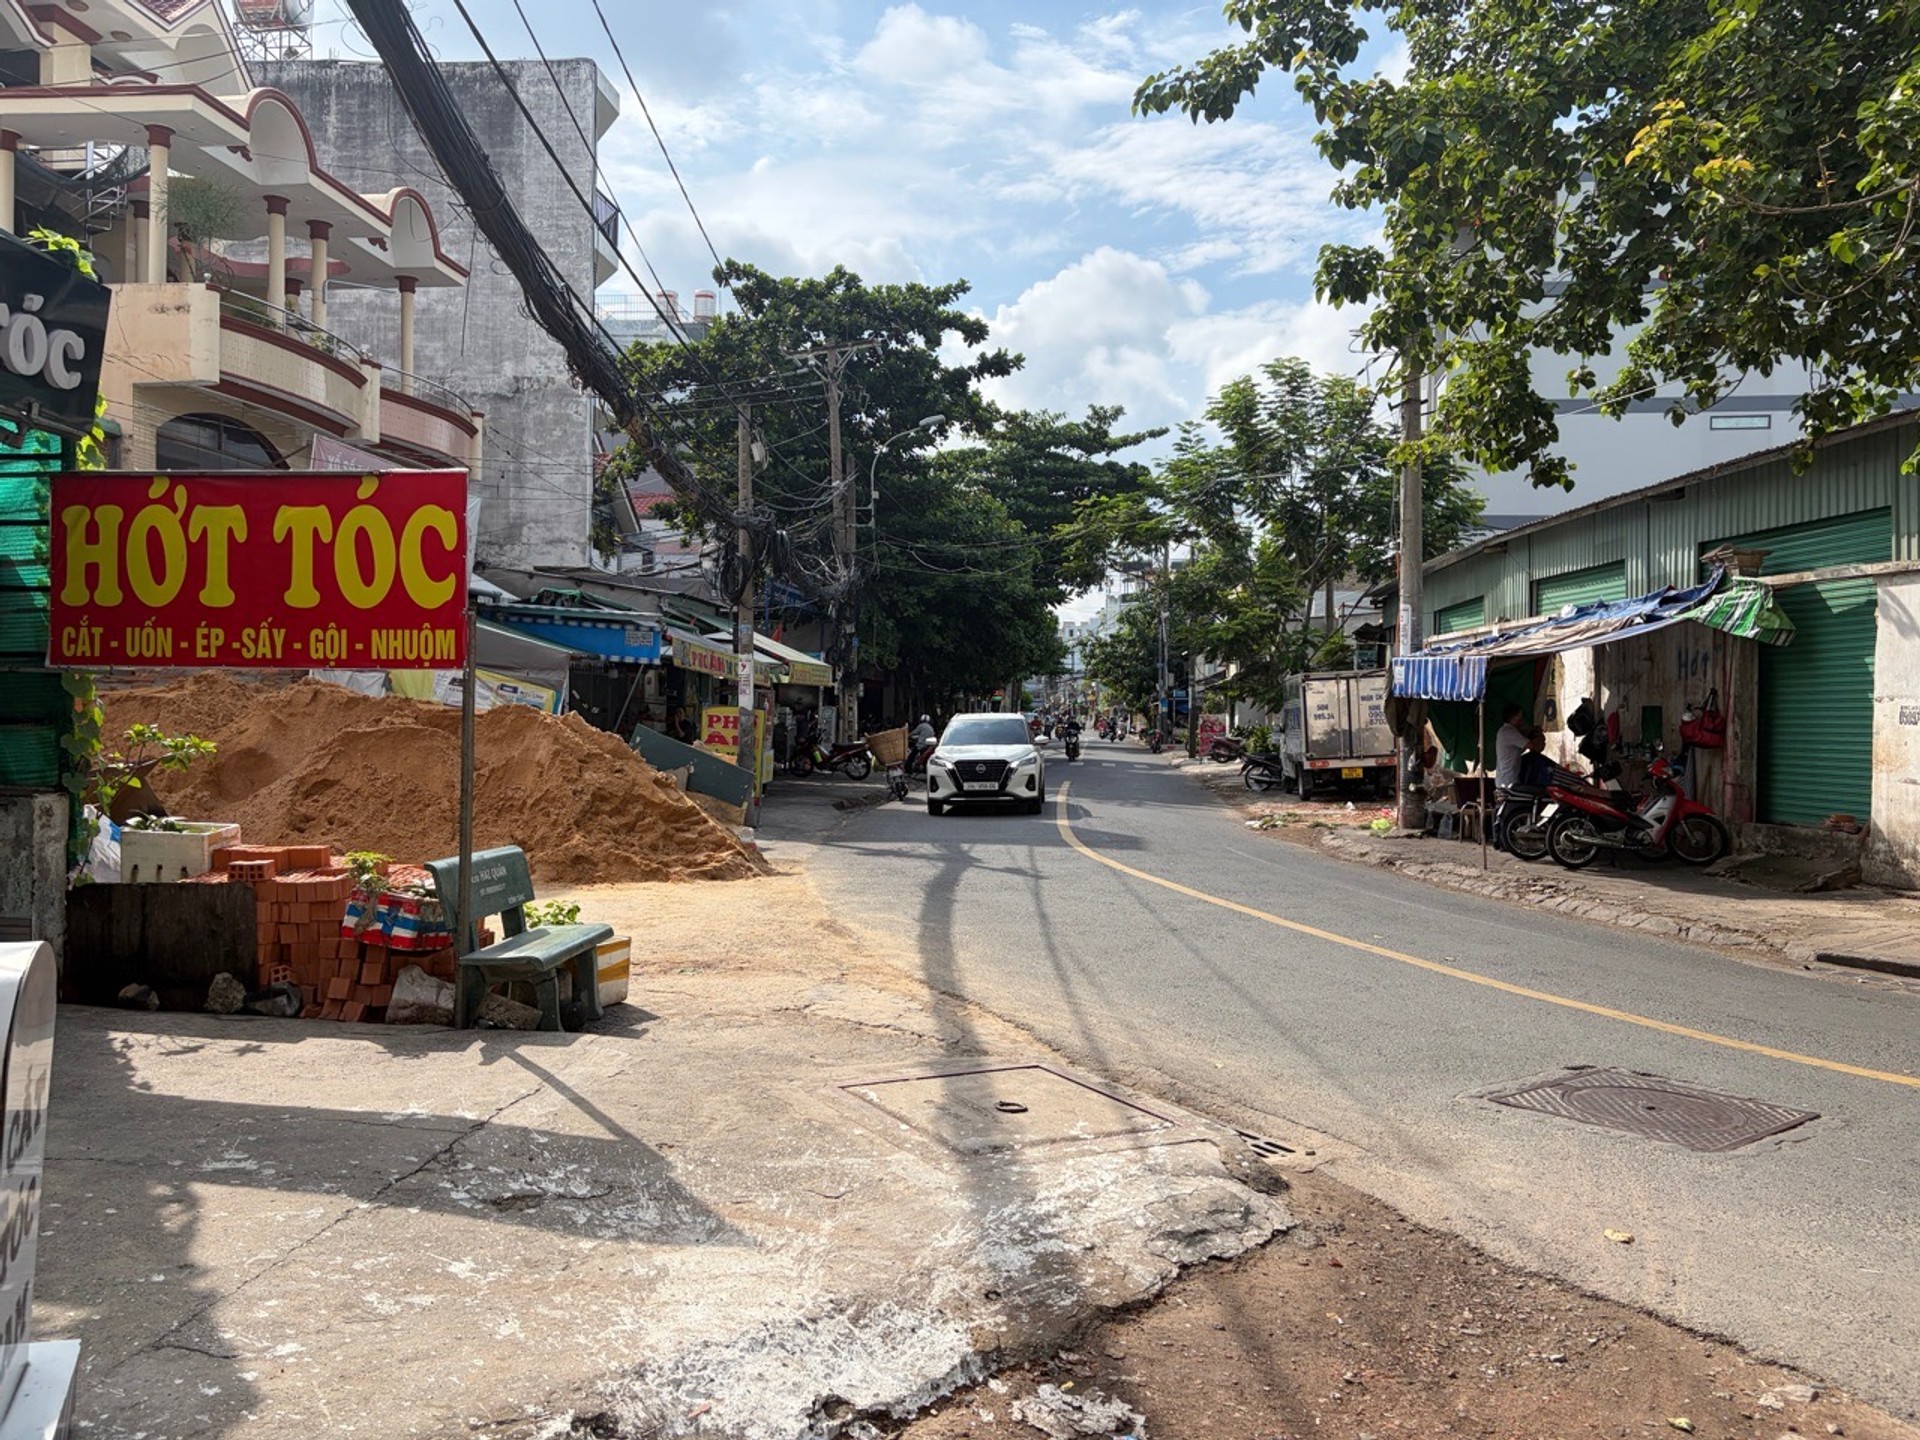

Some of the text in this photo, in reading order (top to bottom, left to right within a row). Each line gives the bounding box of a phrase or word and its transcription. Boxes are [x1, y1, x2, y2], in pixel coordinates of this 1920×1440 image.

[60, 476, 458, 609] HỚT TÓC
[61, 615, 103, 658] CẮT
[125, 615, 173, 658] UỐN
[195, 621, 225, 659] ÉP
[309, 622, 348, 667] GỘI
[371, 622, 457, 668] NHUỘM
